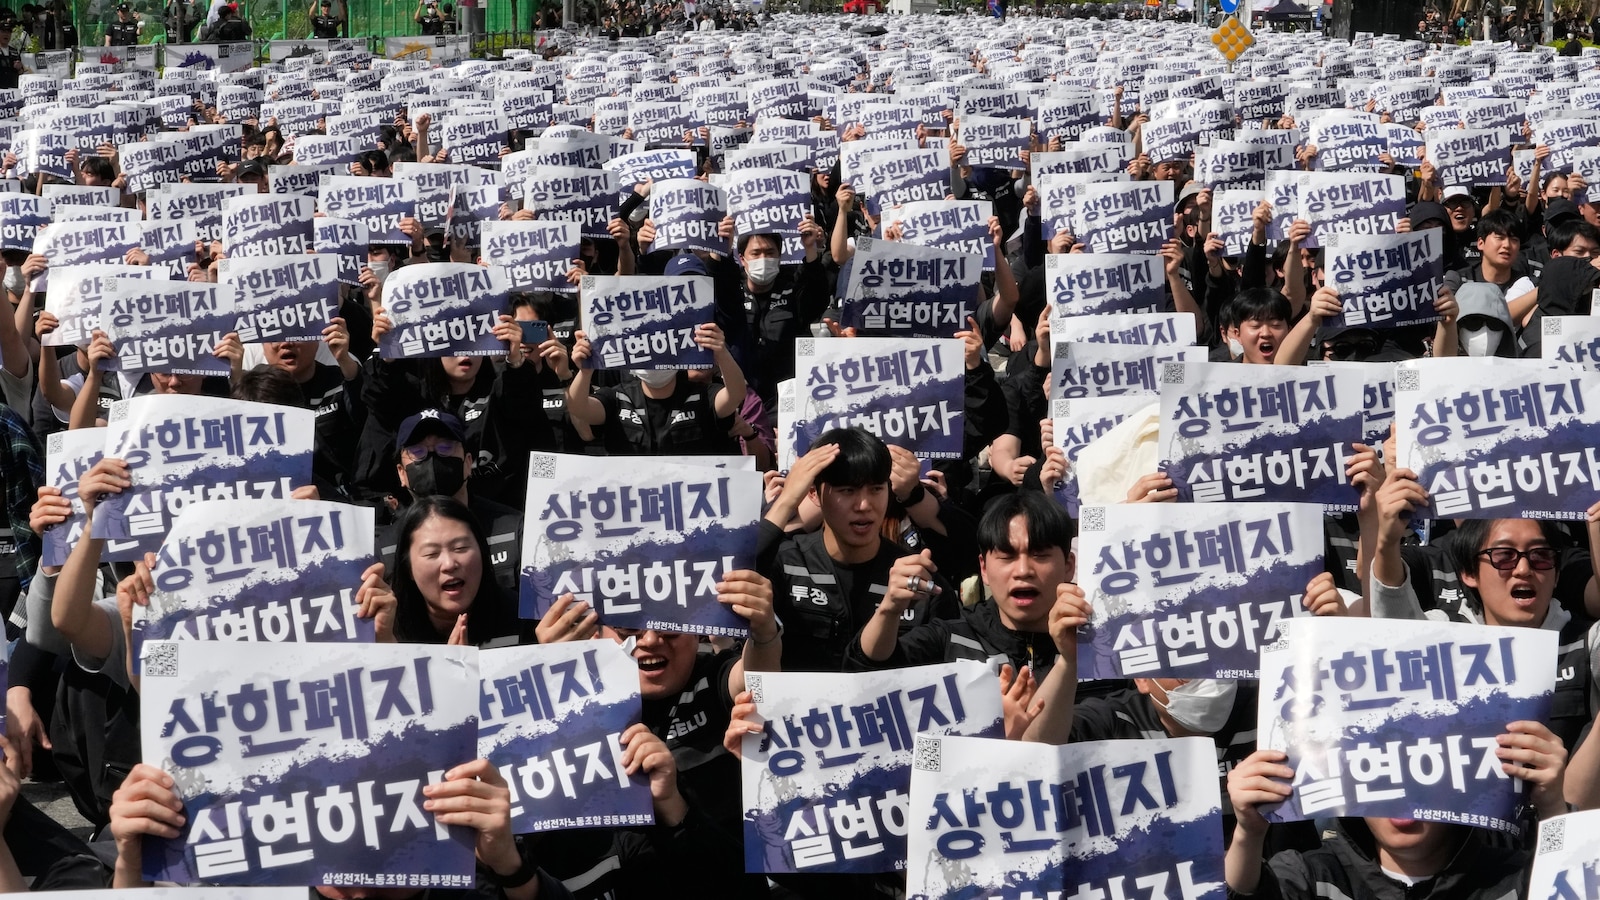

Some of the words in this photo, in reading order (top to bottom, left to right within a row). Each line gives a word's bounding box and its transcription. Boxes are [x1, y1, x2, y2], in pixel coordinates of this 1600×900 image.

[701, 59, 729, 73] 상한폐지
[758, 61, 788, 73] 상한폐지
[946, 67, 976, 78] 상한폐지
[1006, 69, 1040, 83] 상한폐지
[1121, 63, 1158, 76] 상한폐지
[1255, 64, 1285, 77] 상한폐지
[1438, 67, 1469, 79] 상한폐지
[24, 81, 56, 93] 상한폐지
[158, 82, 195, 96] 상한폐지
[278, 82, 310, 95] 상한폐지
[388, 78, 424, 92] 상한폐지
[569, 84, 603, 98] 상한폐지
[634, 86, 674, 102] 상한폐지
[751, 81, 799, 104] 상한폐지
[1237, 84, 1282, 102] 상한폐지
[1447, 89, 1486, 101] 상한폐지
[220, 92, 257, 106] 상한폐지
[356, 94, 399, 110] 상한폐지
[502, 92, 545, 112] 상한폐지
[696, 91, 739, 107] 상한폐지
[964, 93, 1018, 115] 상한폐지
[1294, 91, 1340, 109] 상한폐지
[1390, 88, 1429, 106] 상한폐지
[50, 112, 105, 132] 상한폐지
[223, 107, 259, 120] 실현하자
[277, 104, 316, 119] 상한폐지
[507, 110, 550, 129] 실현하자
[632, 106, 681, 124] 상한폐지
[862, 107, 914, 127] 상한폐지
[1042, 101, 1091, 123] 상한폐지
[1242, 105, 1285, 120] 실현하자
[1466, 102, 1517, 124] 상한폐지
[280, 121, 319, 135] 실현하자
[329, 116, 373, 135] 상한폐지
[447, 118, 499, 140] 상한폐지
[636, 125, 686, 143] 실현하자
[758, 122, 811, 142] 상한폐지
[963, 122, 1021, 142] 상한폐지
[1145, 122, 1192, 145] 상한폐지
[1317, 123, 1378, 143] 상한폐지
[1388, 126, 1414, 139] 폐지
[1542, 122, 1597, 145] 상한폐지
[185, 135, 214, 154] 폐지
[296, 139, 351, 161] 상한폐지
[450, 141, 501, 163] 실현하자
[967, 146, 1022, 165] 실현하자
[1151, 140, 1197, 162] 실현하자
[1320, 144, 1385, 168] 실현하자
[1390, 146, 1419, 159] 하자
[1435, 131, 1499, 160] 상한폐지
[123, 144, 177, 169] 상한폐지
[870, 152, 939, 184] 상한폐지
[1211, 149, 1282, 174] 상한폐지
[129, 168, 184, 191] 실현하자
[417, 168, 469, 193] 한폐지
[1441, 158, 1509, 185] 실현하자
[325, 182, 403, 211] 상한폐지
[531, 173, 608, 201] 상한폐지
[728, 174, 799, 203] 상한폐지
[878, 182, 950, 208] 실현하자
[1305, 178, 1392, 213] 상한폐지
[653, 190, 719, 218] 상한폐지
[1082, 185, 1161, 222] 상한폐지
[227, 198, 301, 237] 상한폐지
[735, 204, 805, 234] 실현하자
[901, 204, 980, 239] 상한폐지
[1314, 212, 1400, 240] 실현하자
[141, 224, 183, 248] 폐지
[487, 225, 567, 259] 상한폐지
[655, 220, 723, 248] 실현하자
[1089, 218, 1175, 253] 실현하자
[1333, 234, 1432, 283] 상한폐지
[226, 257, 322, 302] 상한폐지
[860, 256, 966, 287] 상한폐지
[1053, 260, 1152, 304] 상한폐지
[389, 269, 492, 314] 상한폐지
[590, 281, 697, 325] 상한폐지
[1342, 276, 1442, 326] 실현하자
[110, 287, 216, 327] 상한폐지
[862, 301, 976, 329] 실현하자
[233, 298, 338, 342] 실현하자
[400, 310, 499, 357] 실현하자
[118, 331, 221, 370] 실현하자
[600, 324, 704, 369] 실현하자
[806, 345, 942, 400] 상한폐지
[97, 396, 114, 408] 쟁
[1173, 375, 1336, 438] 상한폐지
[1410, 379, 1584, 446] 상한폐지
[465, 410, 483, 421] SE
[619, 409, 643, 424] 투쟁
[821, 401, 963, 440] 현하자
[114, 412, 287, 469] 상한폐지
[1187, 442, 1350, 502] 실현하자
[1429, 448, 1600, 516] 실현하자
[539, 477, 730, 542] 상한폐지
[1521, 510, 1577, 520] 삼성전자노동조합
[152, 511, 344, 592] 상한폐지
[491, 551, 508, 565] LU
[1093, 512, 1294, 595] 상한폐지
[551, 555, 735, 616] 실현하자
[790, 584, 829, 606] 투쟁
[1438, 588, 1465, 603] 투
[646, 620, 704, 635] 삼성전자노동조합
[705, 623, 748, 637] 공동투쟁본부
[1113, 594, 1308, 676] 실현하자
[1216, 669, 1261, 678] 삼성전자노동
[1273, 637, 1516, 721] 상한폐지
[478, 649, 605, 738] 폐지
[160, 656, 434, 769] 상한폐지
[667, 711, 708, 740] SELU
[759, 673, 966, 777] 상한폐지
[499, 732, 630, 818] 하자
[1292, 735, 1522, 816] 실현하자
[926, 750, 1178, 859] 상한폐지
[187, 770, 450, 878] 실현하자
[533, 816, 602, 831] 삼성전자노동조합
[603, 814, 652, 826] 공동투쟁본부
[784, 789, 909, 869] 실현
[1413, 808, 1489, 827] 삼성전자노동조합
[322, 872, 406, 886] 삼성전자노동조합
[409, 873, 473, 886] 공동투쟁본부
